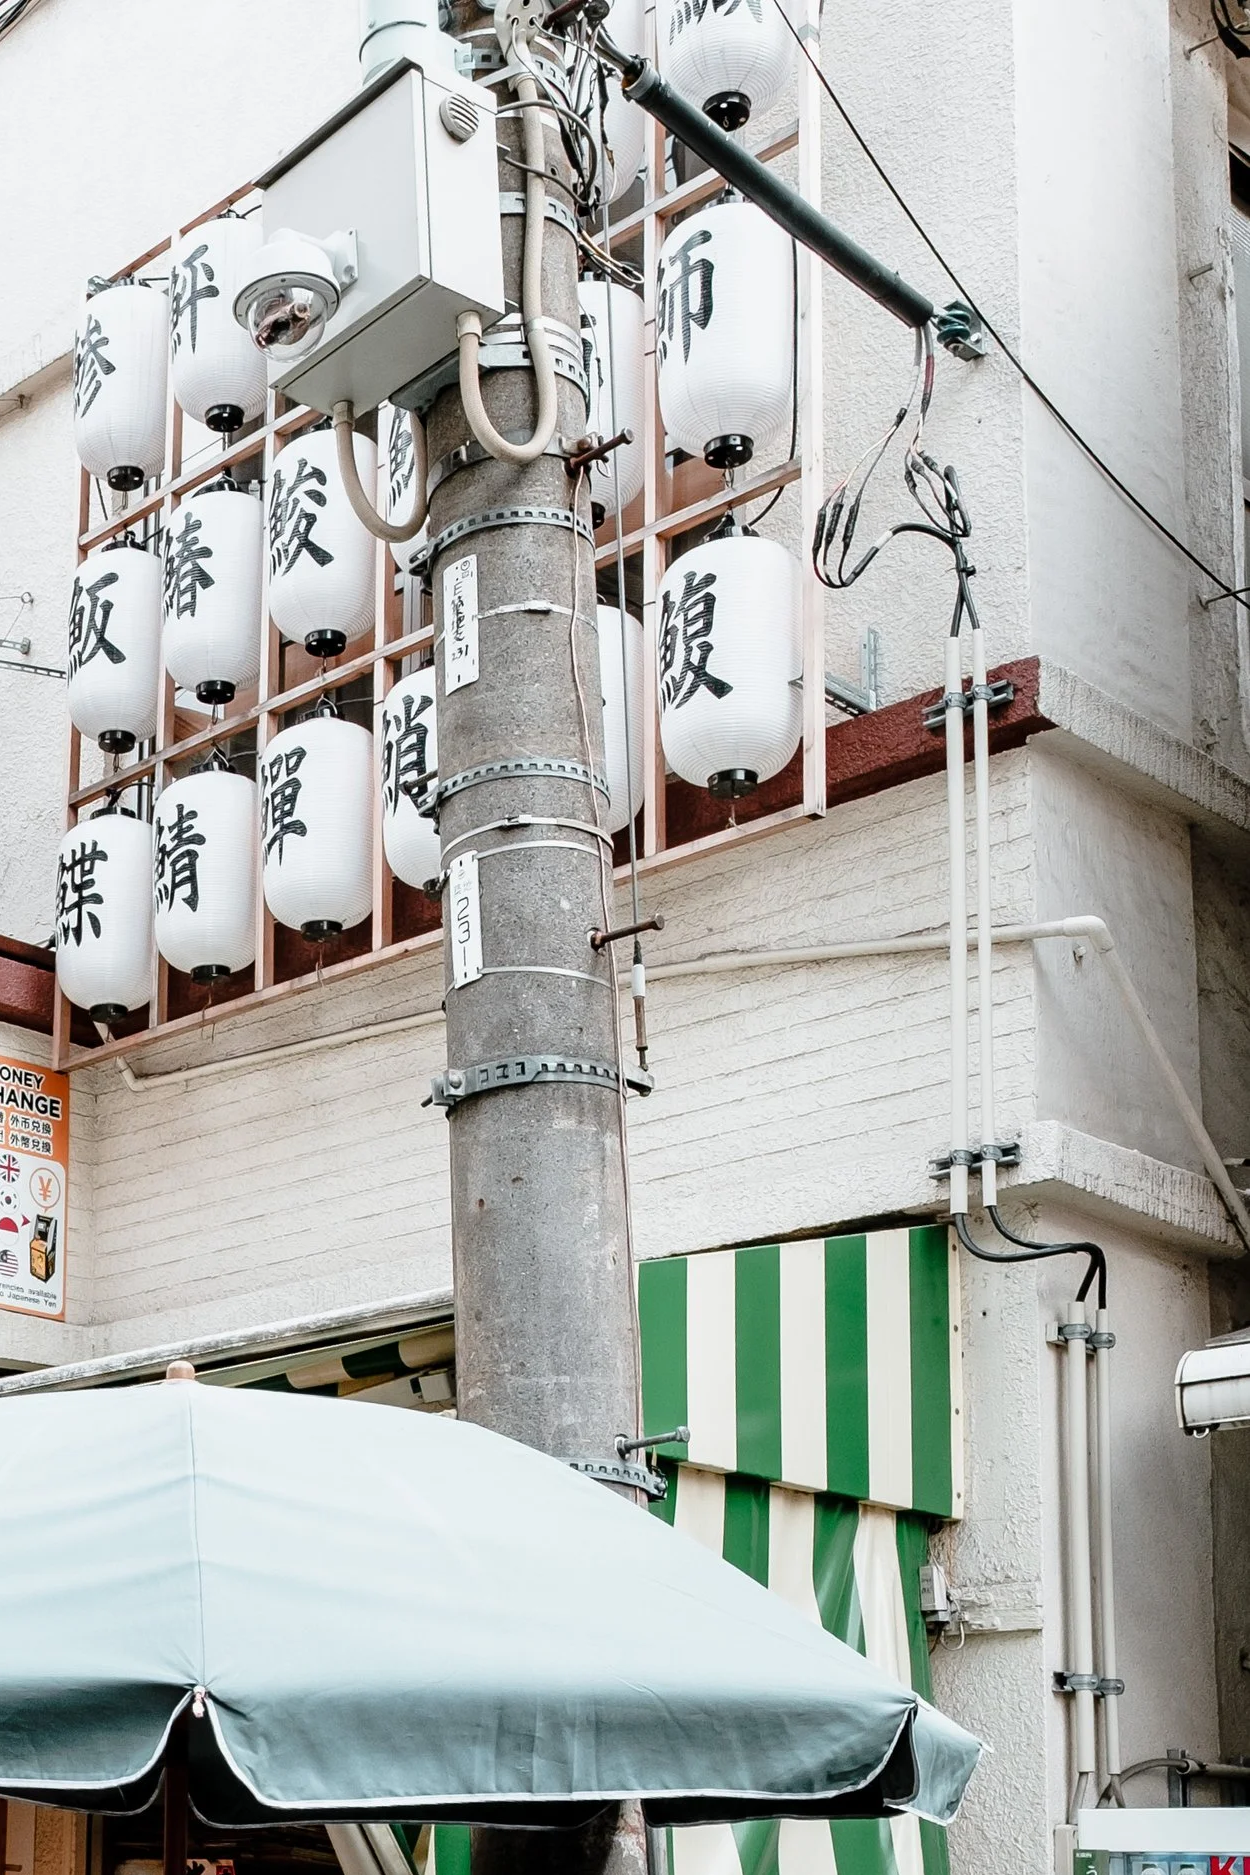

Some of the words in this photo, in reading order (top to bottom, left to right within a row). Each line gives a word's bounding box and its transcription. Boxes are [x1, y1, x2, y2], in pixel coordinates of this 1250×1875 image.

[7, 1292, 40, 1305] Japanese
[43, 1298, 57, 1308] Yen
[28, 1286, 57, 1300] available
